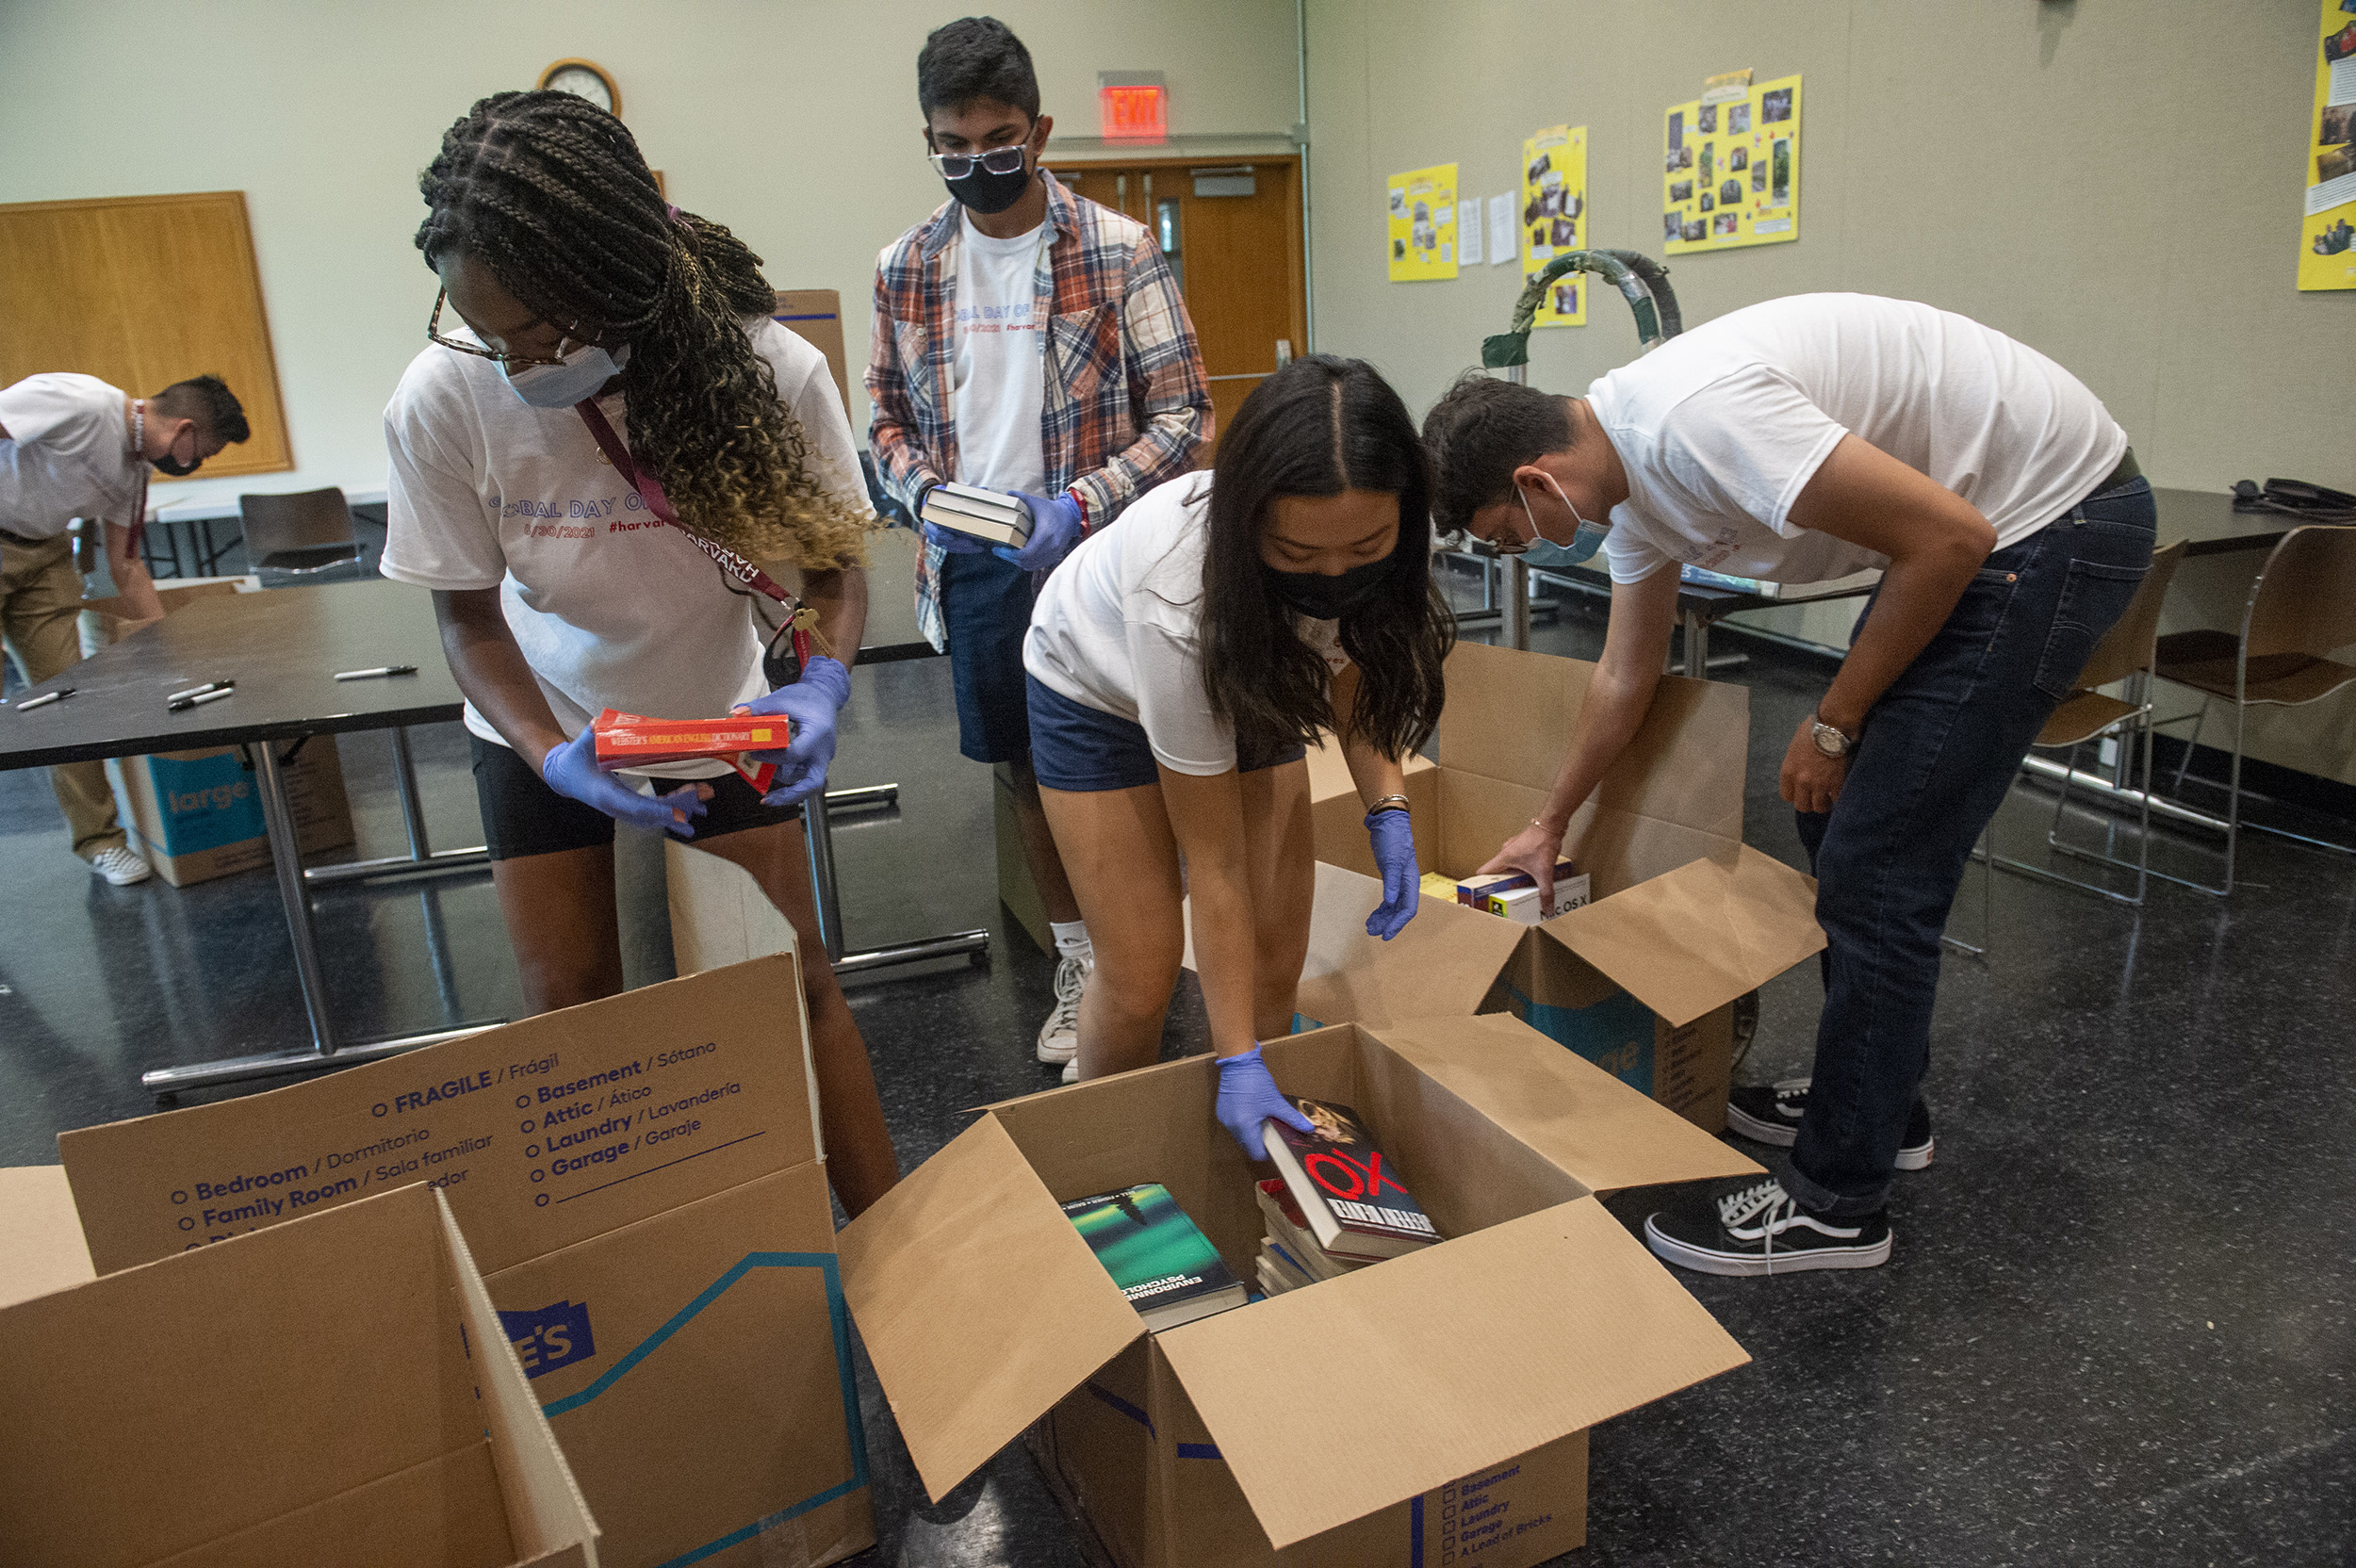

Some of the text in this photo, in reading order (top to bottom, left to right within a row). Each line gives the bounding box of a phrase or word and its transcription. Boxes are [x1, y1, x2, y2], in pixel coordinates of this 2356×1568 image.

[1111, 90, 1158, 125] EXIT
[984, 305, 1010, 318] DAY
[1013, 303, 1030, 318] OF
[488, 492, 648, 519] GOBAL DAY O
[524, 519, 665, 539] 8/30/2021 #harvar
[680, 528, 752, 583] ARVARD
[169, 781, 250, 814] large
[1563, 897, 1579, 913] OS
[1579, 895, 1588, 907] X
[395, 1070, 493, 1114] FRAGILE
[509, 1053, 560, 1080] Frágil
[537, 1060, 643, 1103] Basement
[658, 1042, 716, 1068] Sótano
[543, 1101, 594, 1129] Attic
[609, 1086, 652, 1108] Ático
[547, 1115, 632, 1153] Laundry
[648, 1082, 741, 1120] Lavandería
[551, 1140, 630, 1176] Garage
[646, 1119, 702, 1146] Garaje
[196, 1164, 308, 1201] Bedroom
[327, 1129, 430, 1168] Dormitorio
[203, 1196, 284, 1227] Family
[289, 1177, 358, 1209] Room
[376, 1157, 418, 1181] Sala
[422, 1135, 494, 1167] familiar
[427, 1168, 468, 1192] edor
[1121, 1273, 1186, 1296] PSYCHOLO
[1125, 1276, 1203, 1302] ENVIRONME
[512, 1324, 573, 1370] E'S
[1461, 1464, 1520, 1496] Basement
[1461, 1501, 1510, 1527] Laundry
[1462, 1494, 1489, 1512] Attic
[1461, 1519, 1504, 1543] Garage
[1502, 1527, 1513, 1541] of
[1516, 1513, 1553, 1536] Bricks
